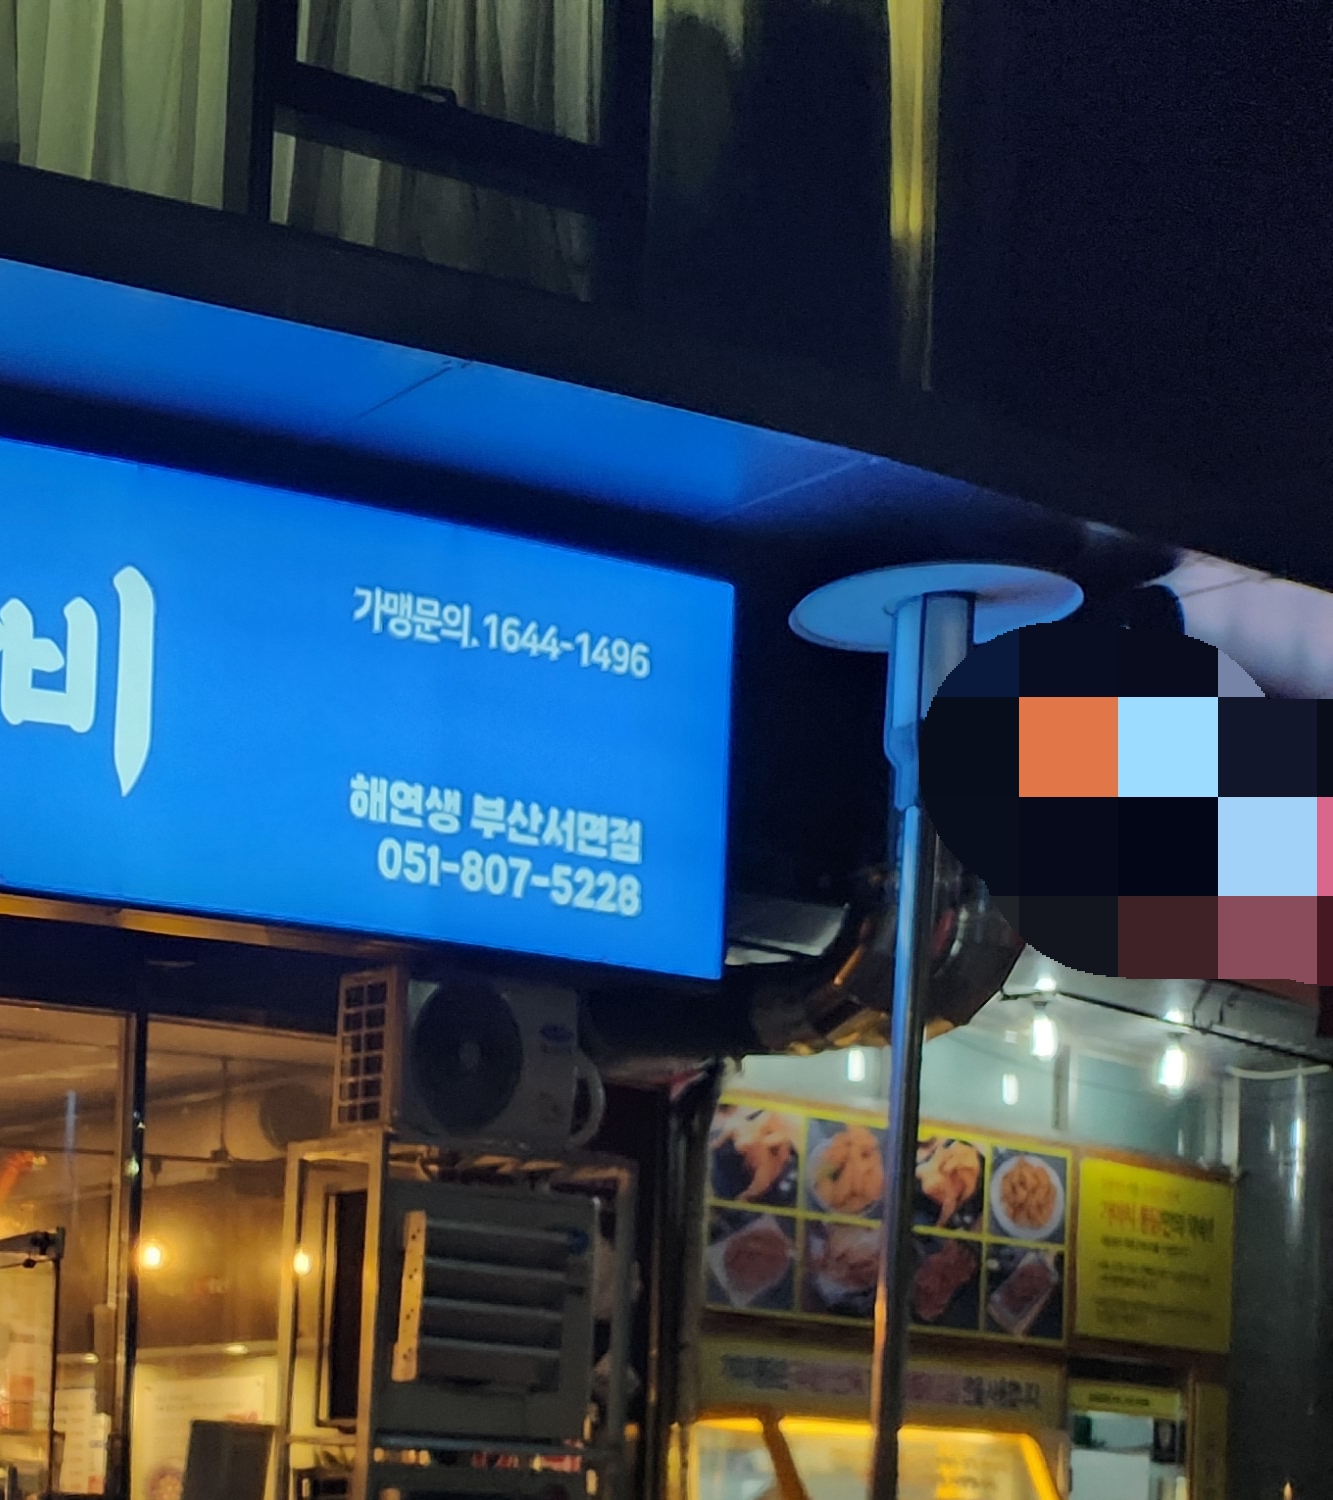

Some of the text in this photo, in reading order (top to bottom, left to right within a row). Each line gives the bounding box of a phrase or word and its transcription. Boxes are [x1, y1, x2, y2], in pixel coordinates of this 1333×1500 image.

[484, 613, 651, 679] 1644-1496
[349, 773, 643, 864] 해연생 부산서면점
[377, 838, 642, 917] 051-807-5228
